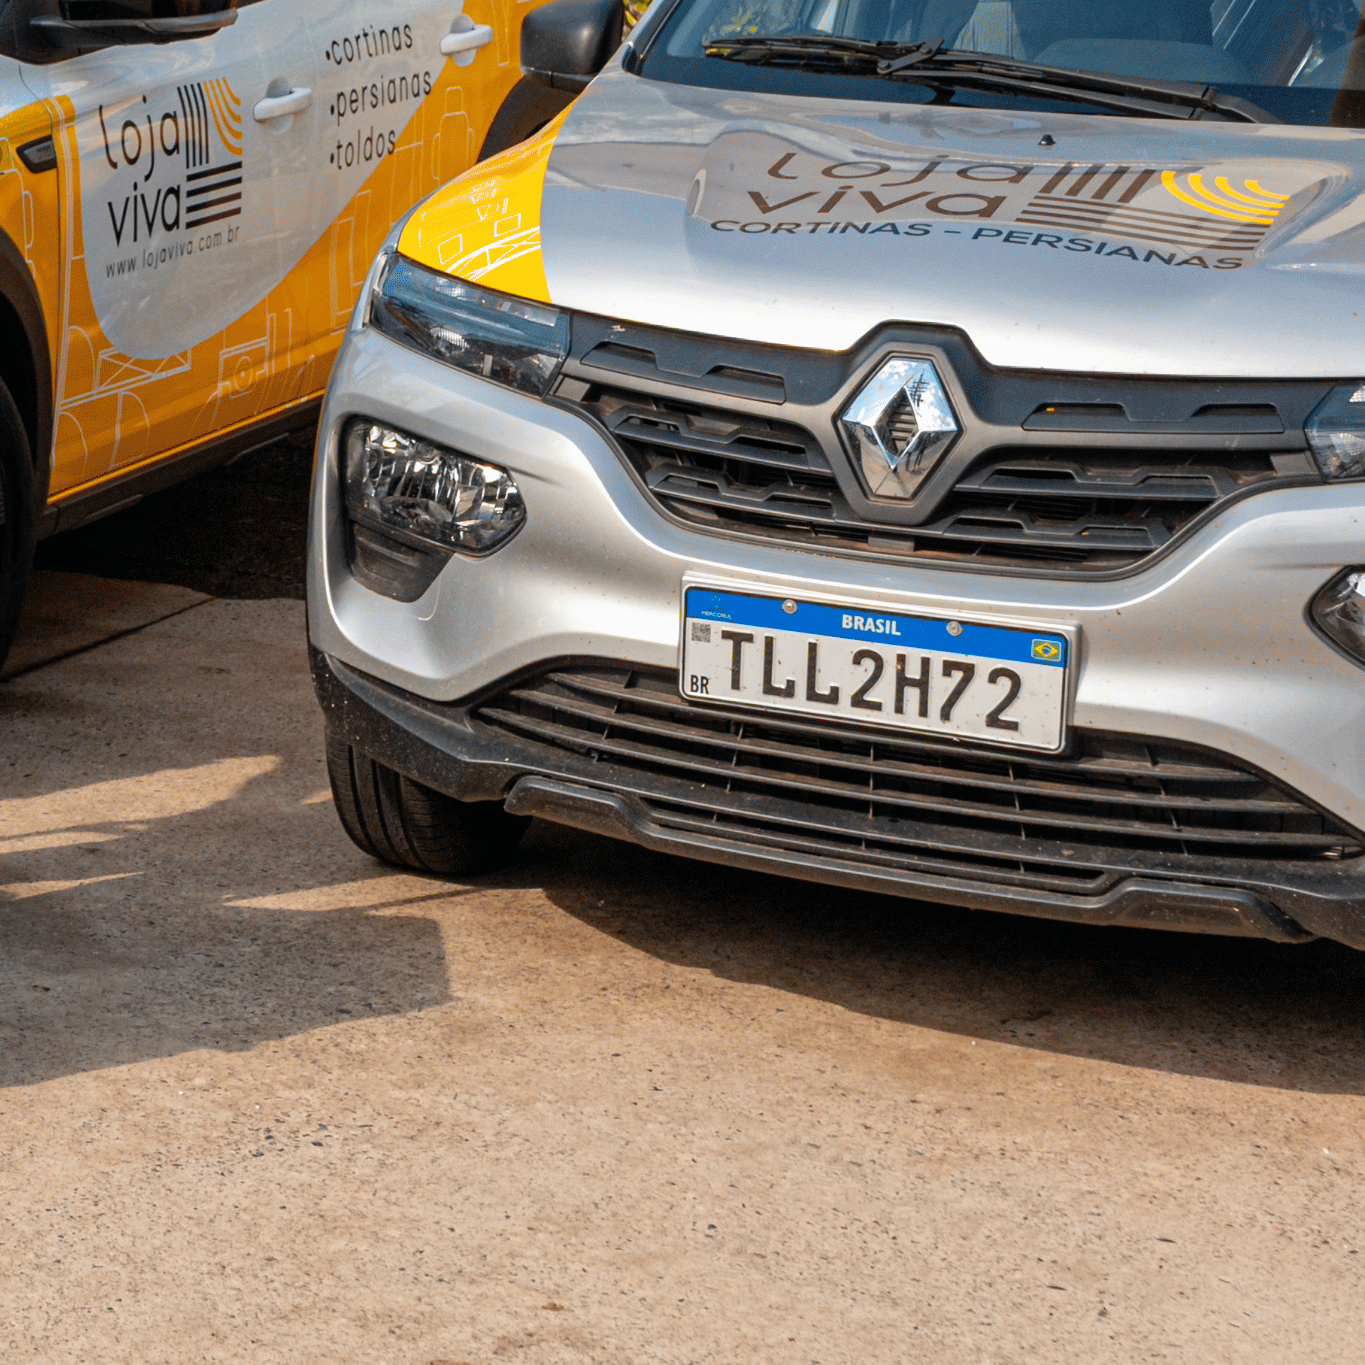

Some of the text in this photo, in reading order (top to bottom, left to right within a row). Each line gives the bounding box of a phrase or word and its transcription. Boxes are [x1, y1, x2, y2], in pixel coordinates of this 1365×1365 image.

[331, 23, 413, 66] cortinas
[337, 70, 432, 126] persianas
[99, 94, 180, 182] loja
[337, 125, 396, 170] toldos
[767, 152, 1035, 187] loja
[107, 181, 181, 248] viva
[747, 184, 1007, 220] viva
[710, 219, 933, 236] CORTINAS
[971, 226, 1243, 271] PERSIANAS
[841, 614, 902, 636] BRASIL
[690, 674, 710, 695] BR
[721, 629, 1022, 731] TLL2H72
